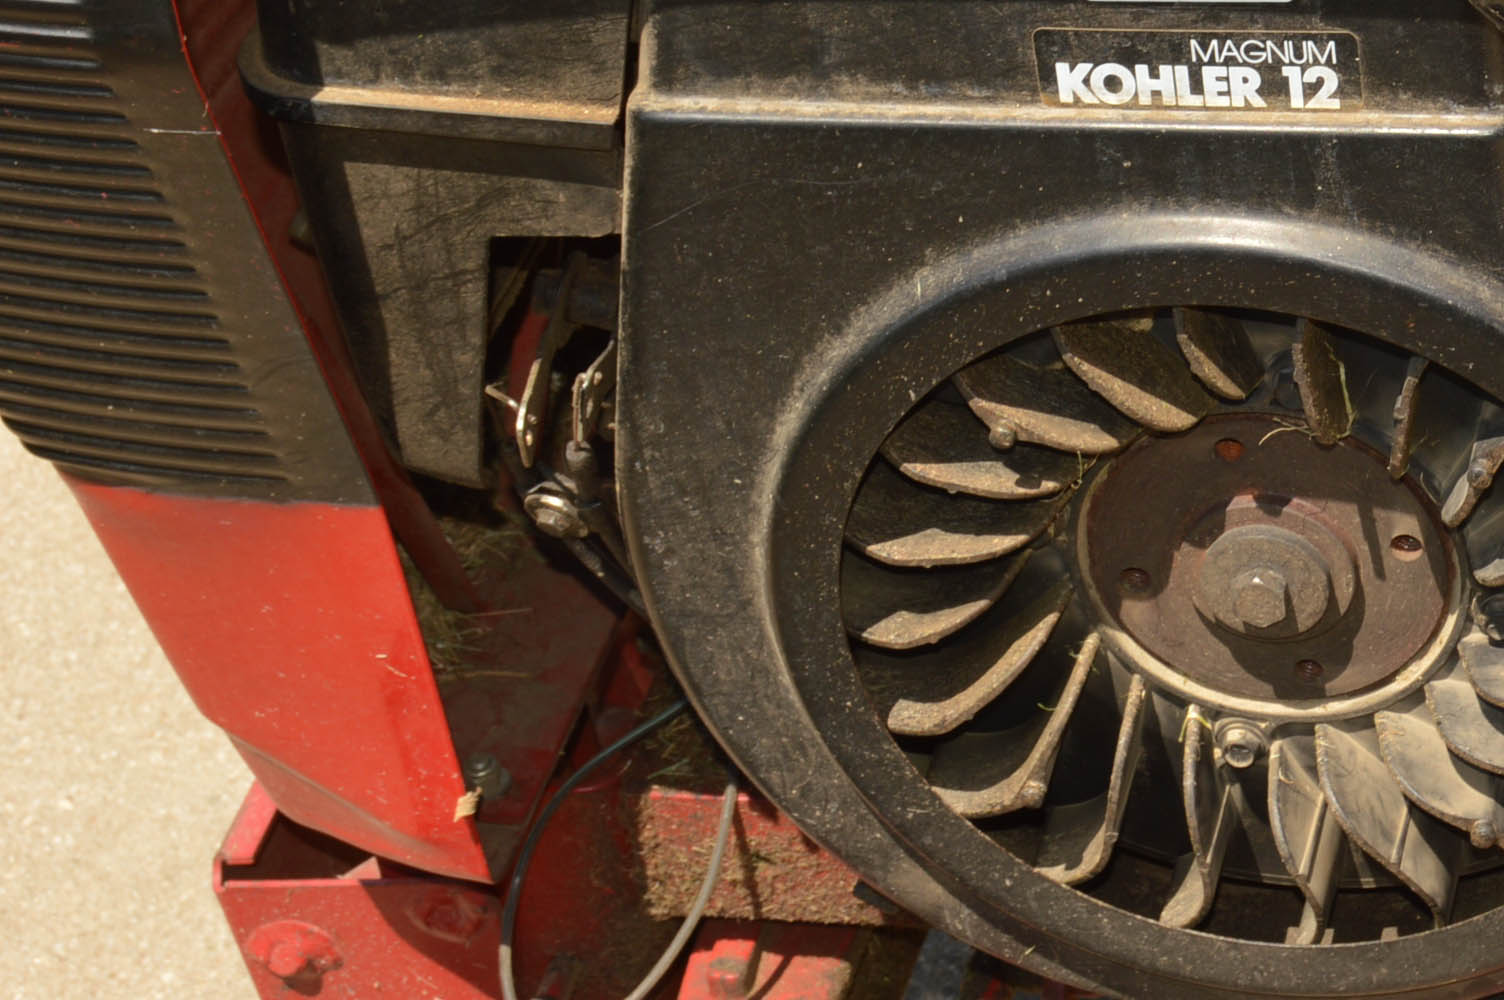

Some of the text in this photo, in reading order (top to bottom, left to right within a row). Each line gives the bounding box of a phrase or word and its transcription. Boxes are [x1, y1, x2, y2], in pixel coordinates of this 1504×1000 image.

[1190, 39, 1337, 64] MAGNUM
[1055, 62, 1341, 109] KOHLER 12
